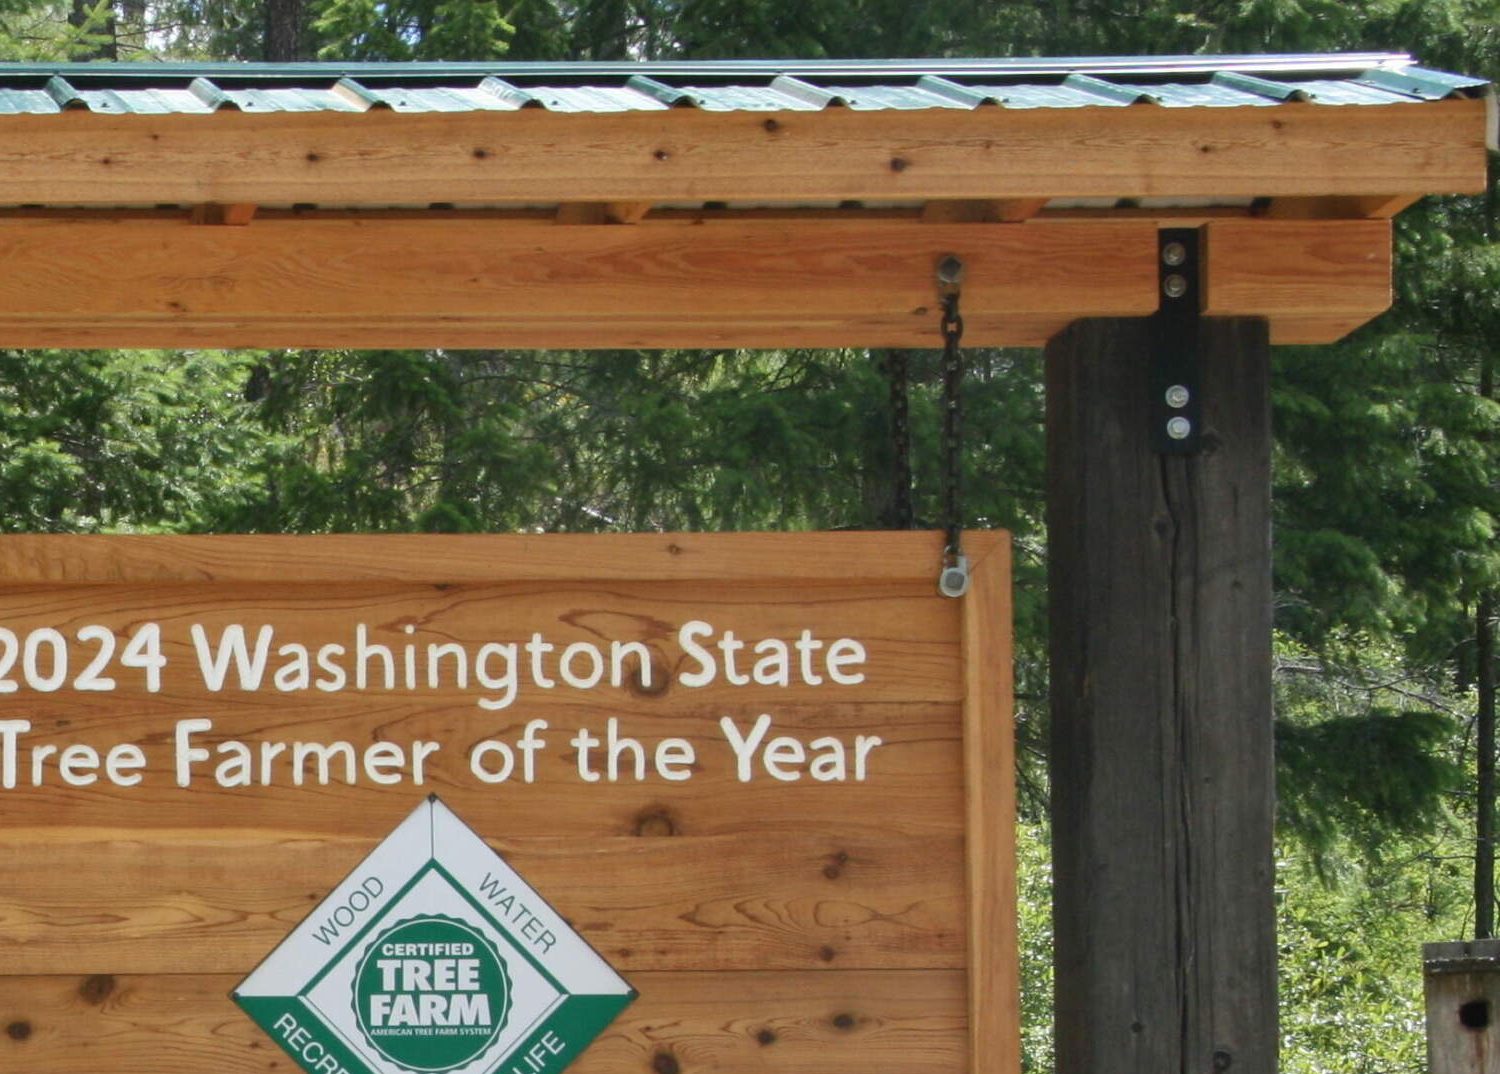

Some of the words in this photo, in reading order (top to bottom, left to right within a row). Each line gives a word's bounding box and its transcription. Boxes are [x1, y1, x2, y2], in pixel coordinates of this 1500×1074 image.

[191, 623, 652, 711] Washington
[679, 620, 866, 687] State
[175, 718, 440, 787] Farmer
[470, 719, 549, 783] of
[570, 717, 696, 782] the
[720, 714, 882, 782] Year
[312, 876, 384, 946] WOOD
[479, 872, 557, 954] WATER
[377, 959, 480, 991] TREE
[382, 943, 474, 956] CERTIFIED
[370, 994, 491, 1026] FARM
[370, 1028, 413, 1036] AMERICAN
[414, 1028, 433, 1036] TREE
[435, 1028, 458, 1036] FARM
[459, 1027, 491, 1036] SYSTEM
